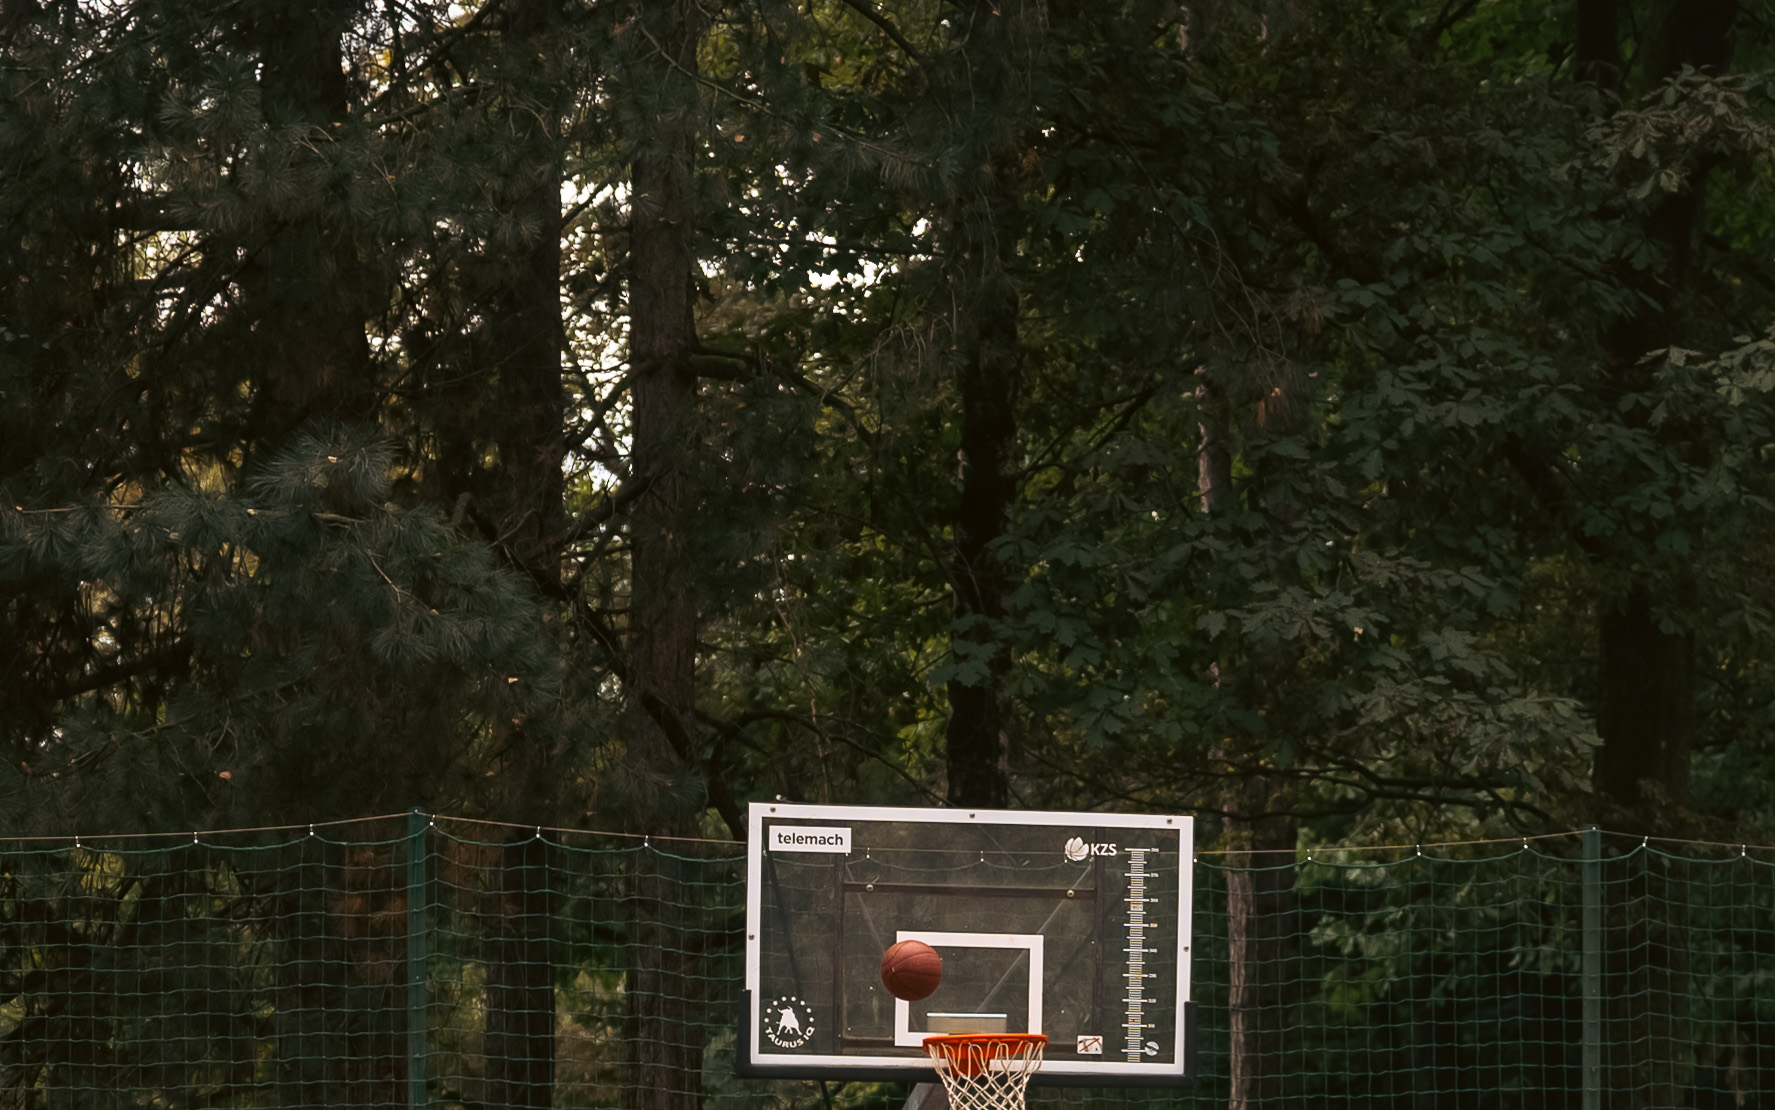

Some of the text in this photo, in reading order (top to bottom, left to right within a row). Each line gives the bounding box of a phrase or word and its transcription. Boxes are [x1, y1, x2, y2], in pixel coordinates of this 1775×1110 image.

[777, 832, 844, 846] telemach
[1090, 843, 1117, 857] KZS
[765, 1026, 816, 1049] TAURUS IQ
